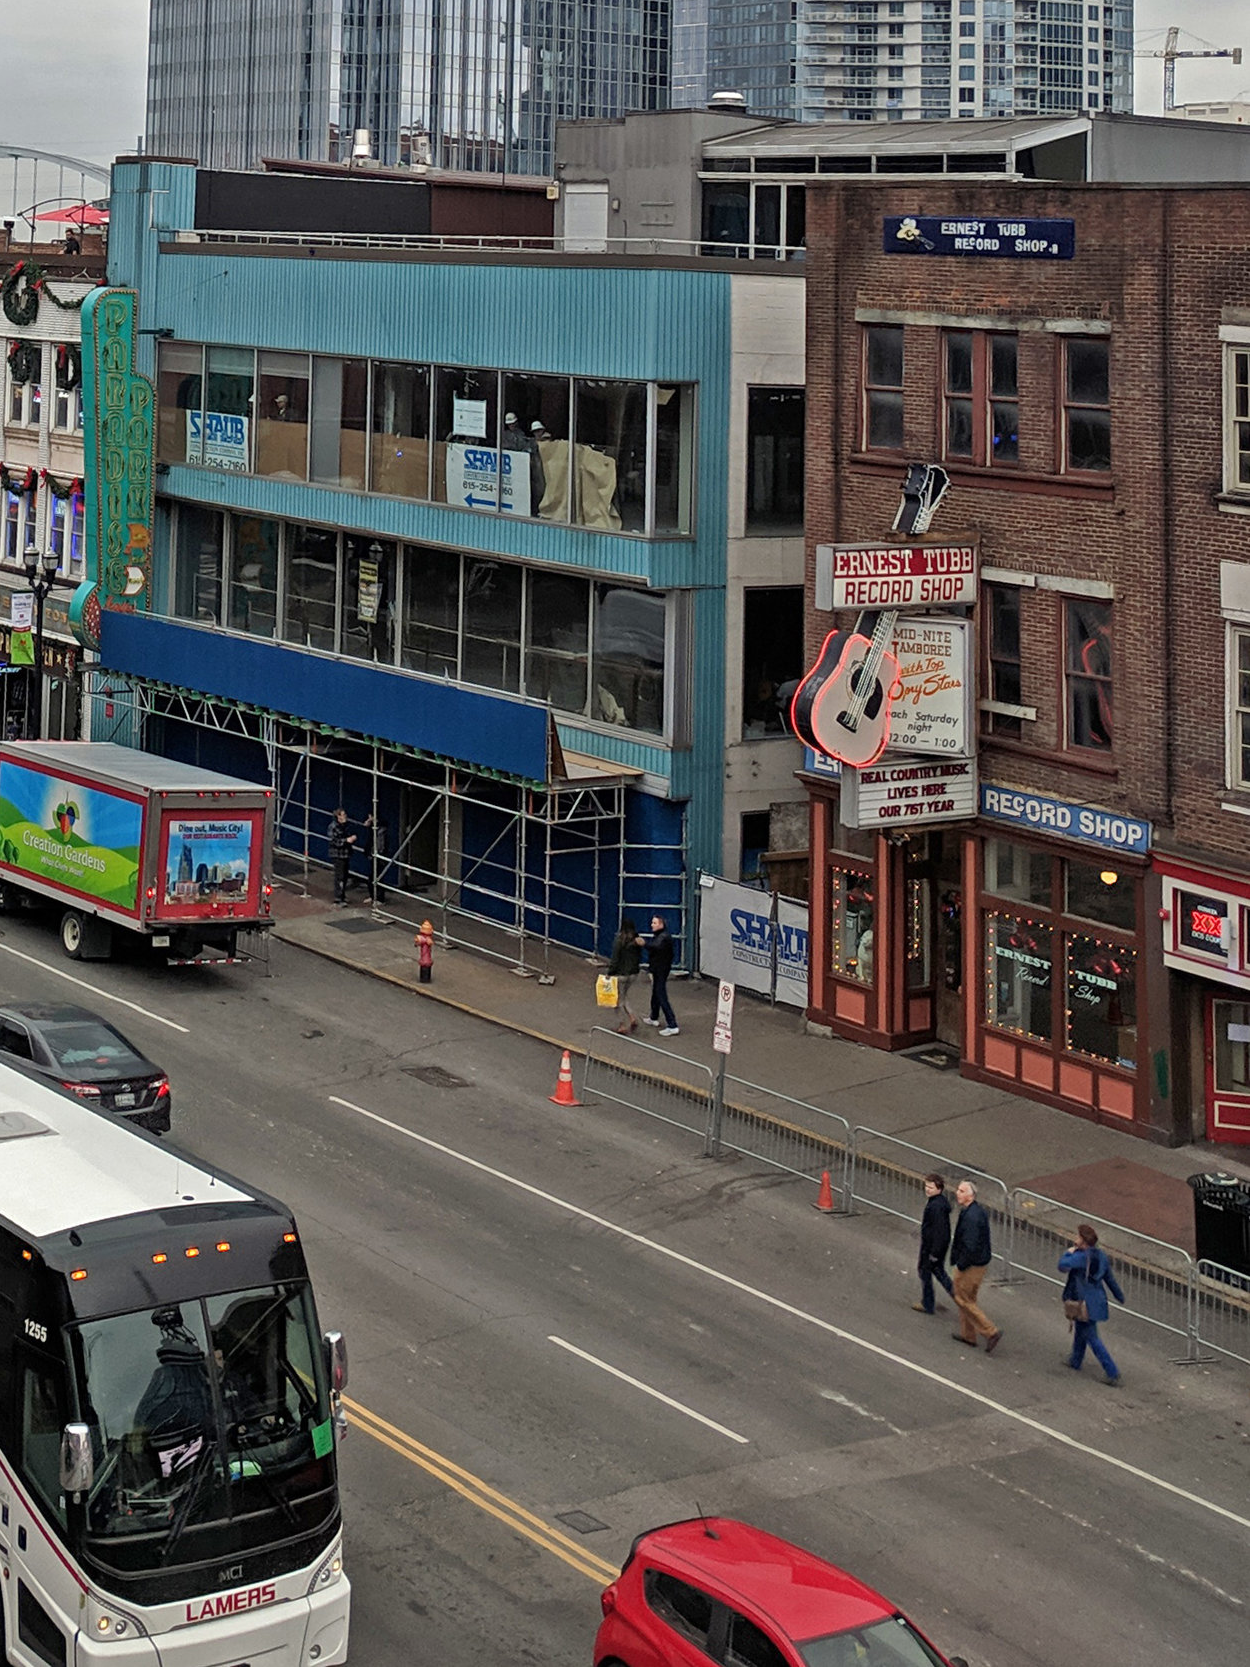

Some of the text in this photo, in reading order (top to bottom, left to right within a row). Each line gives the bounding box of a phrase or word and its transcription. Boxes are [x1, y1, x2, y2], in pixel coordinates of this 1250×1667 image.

[941, 221, 1026, 236] ERNEST TUBB
[955, 237, 1048, 252] RECORD SHOP
[104, 298, 128, 595] PARADISE
[127, 382, 150, 519] PARK
[463, 481, 513, 495] 615-254-160
[835, 548, 972, 576] ERNEST TUBB
[844, 577, 964, 605] RECORD SHOP
[893, 627, 952, 644] MID-NITE
[926, 657, 944, 672] Top
[887, 674, 962, 705] Opry Stars
[907, 723, 932, 734] night
[915, 712, 959, 728] Saturday
[934, 737, 957, 749] 1:00
[861, 763, 970, 784] REAL COUNTRY MUSIC
[887, 783, 948, 800] LIVES HERE
[878, 800, 955, 818] OUR 71ST YEAR
[985, 789, 1142, 846] RECORD SHOP
[209, 824, 227, 832] Music
[228, 823, 244, 834] City!
[22, 827, 106, 873] Creation Gardens
[730, 908, 808, 966] SHAU
[995, 946, 1052, 970] ERNEST
[779, 967, 808, 981] COMPAN
[1015, 966, 1049, 986] Record
[1075, 969, 1117, 991] TUBB
[1074, 985, 1101, 1006] Shop
[23, 1317, 47, 1343] 1255
[218, 1564, 244, 1583] MCI
[186, 1583, 276, 1622] LAMERS
